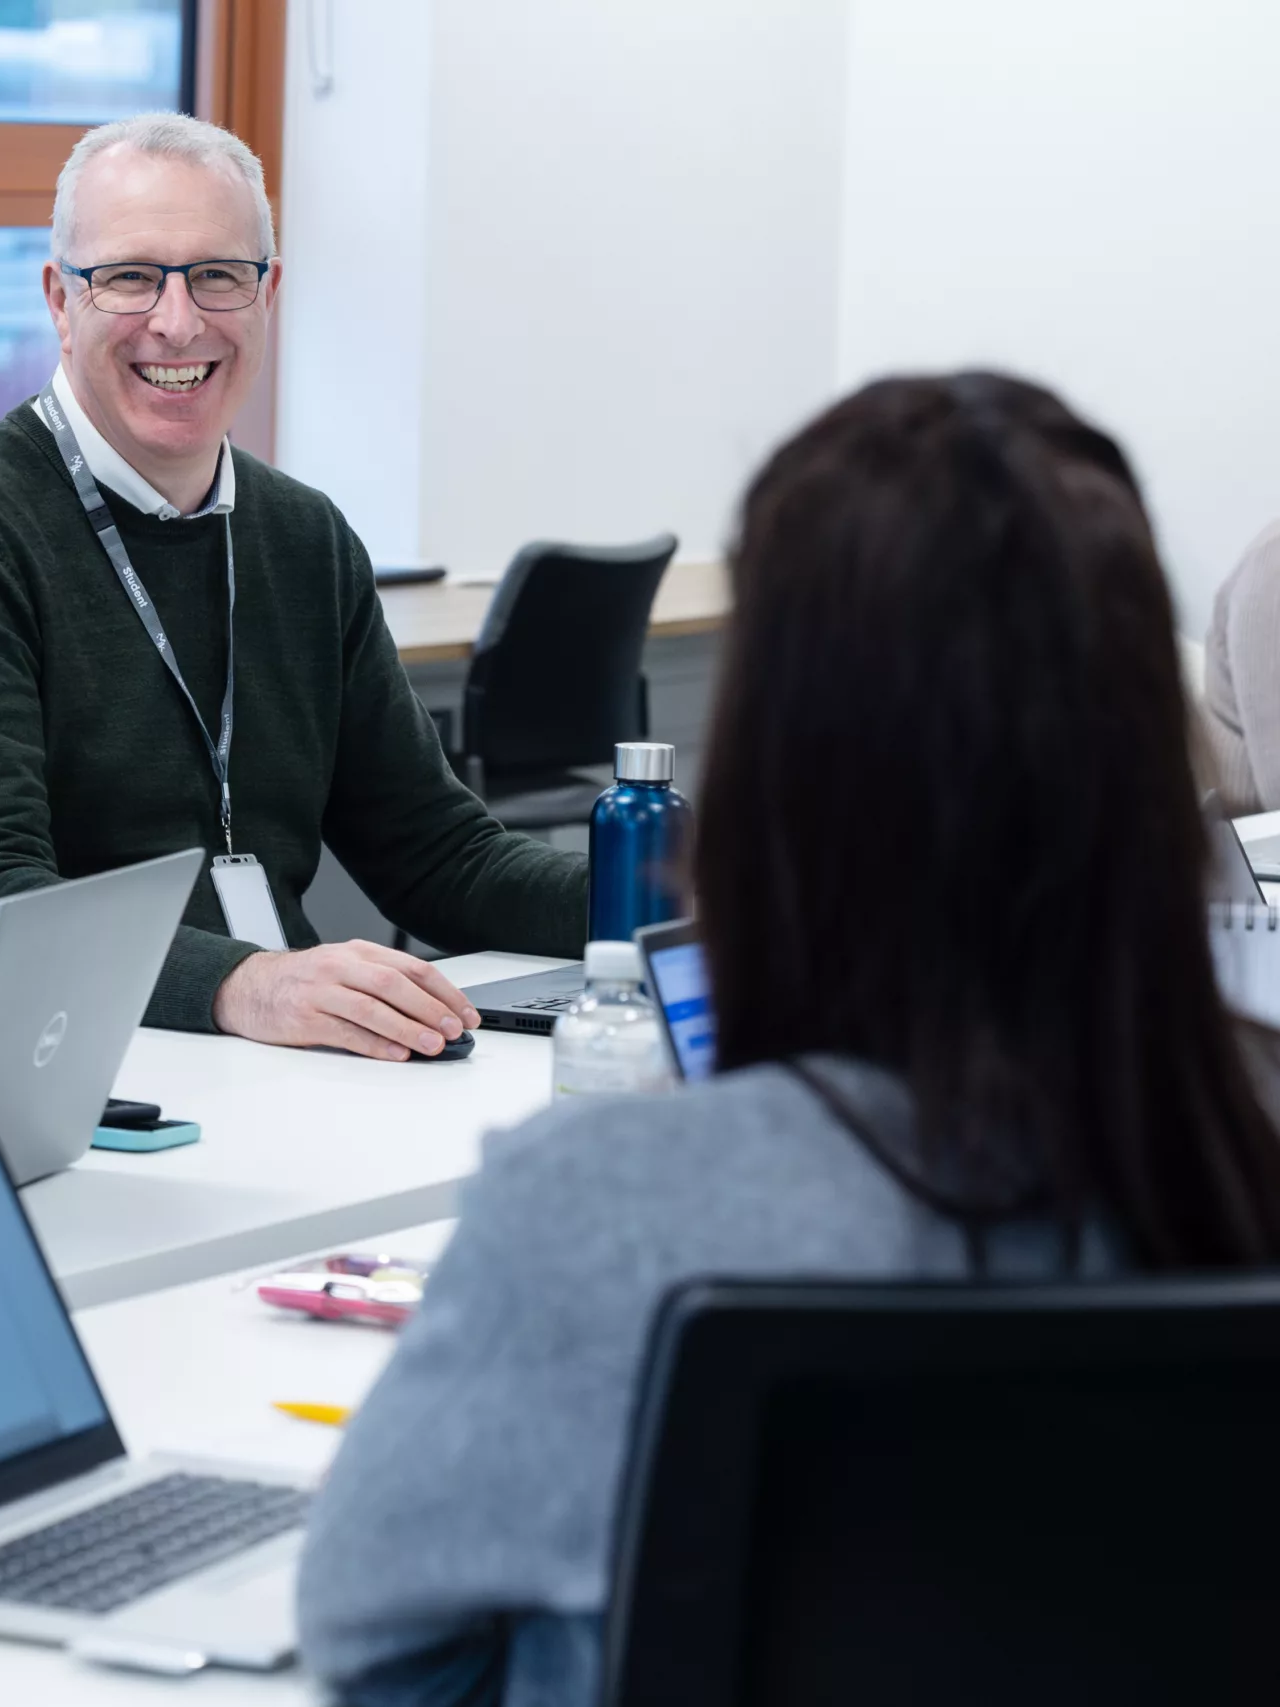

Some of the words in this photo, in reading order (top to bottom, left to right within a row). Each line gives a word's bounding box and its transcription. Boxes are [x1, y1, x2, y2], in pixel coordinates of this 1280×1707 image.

[44, 395, 66, 431] Student
[123, 566, 148, 608] Student
[220, 713, 230, 756] Student
